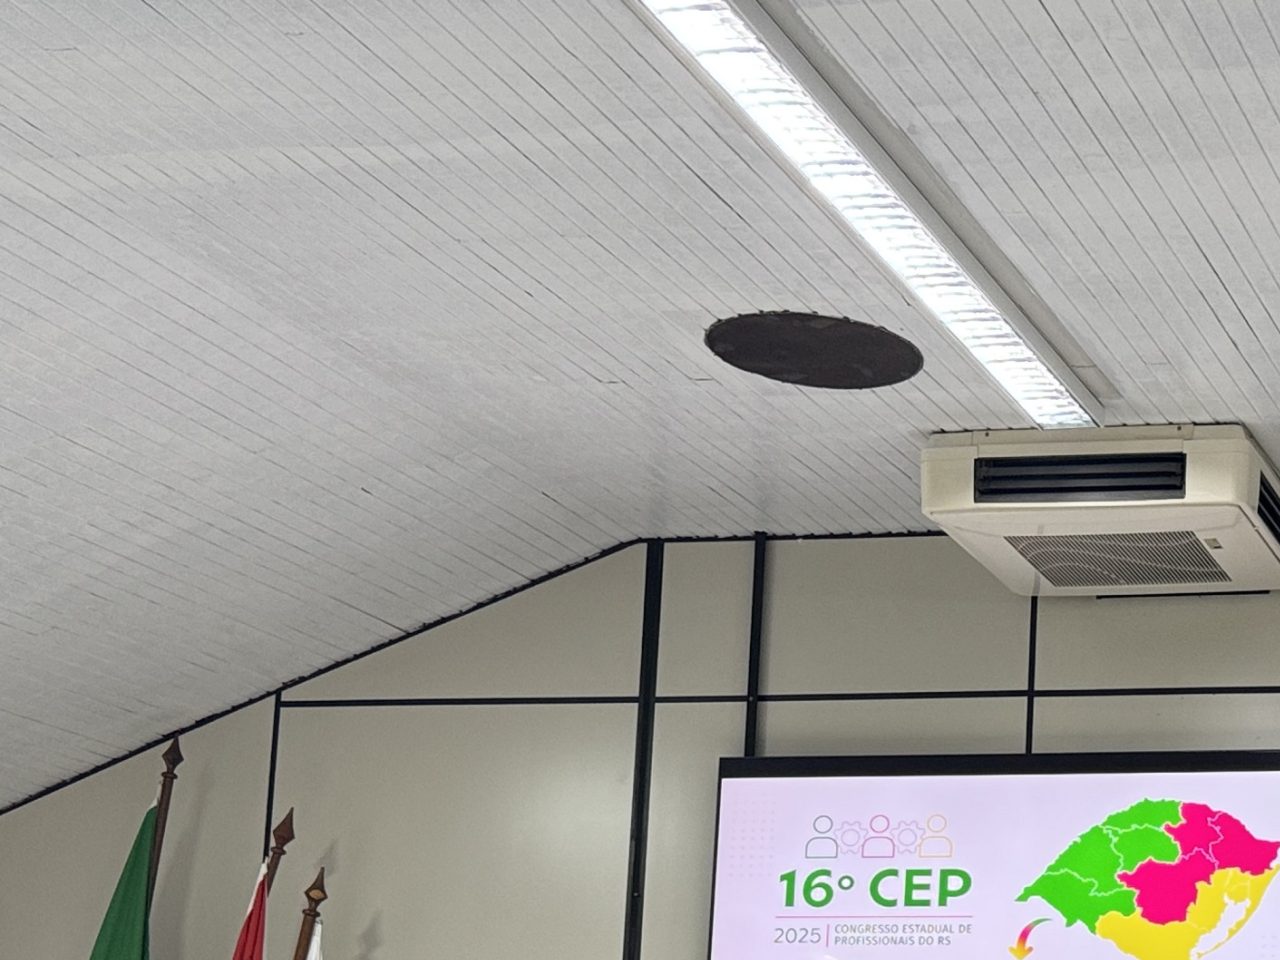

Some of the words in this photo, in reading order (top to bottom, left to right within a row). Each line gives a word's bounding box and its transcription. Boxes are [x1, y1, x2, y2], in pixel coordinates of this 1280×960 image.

[869, 868, 972, 908] CEP
[774, 927, 821, 944] 2025
[834, 923, 899, 934] CONGRESSO
[902, 923, 955, 934] ESTADUAL
[958, 923, 973, 934] DE
[834, 935, 916, 946] PROFISSIONAIS
[918, 935, 934, 946] DO
[937, 935, 952, 946] RS
